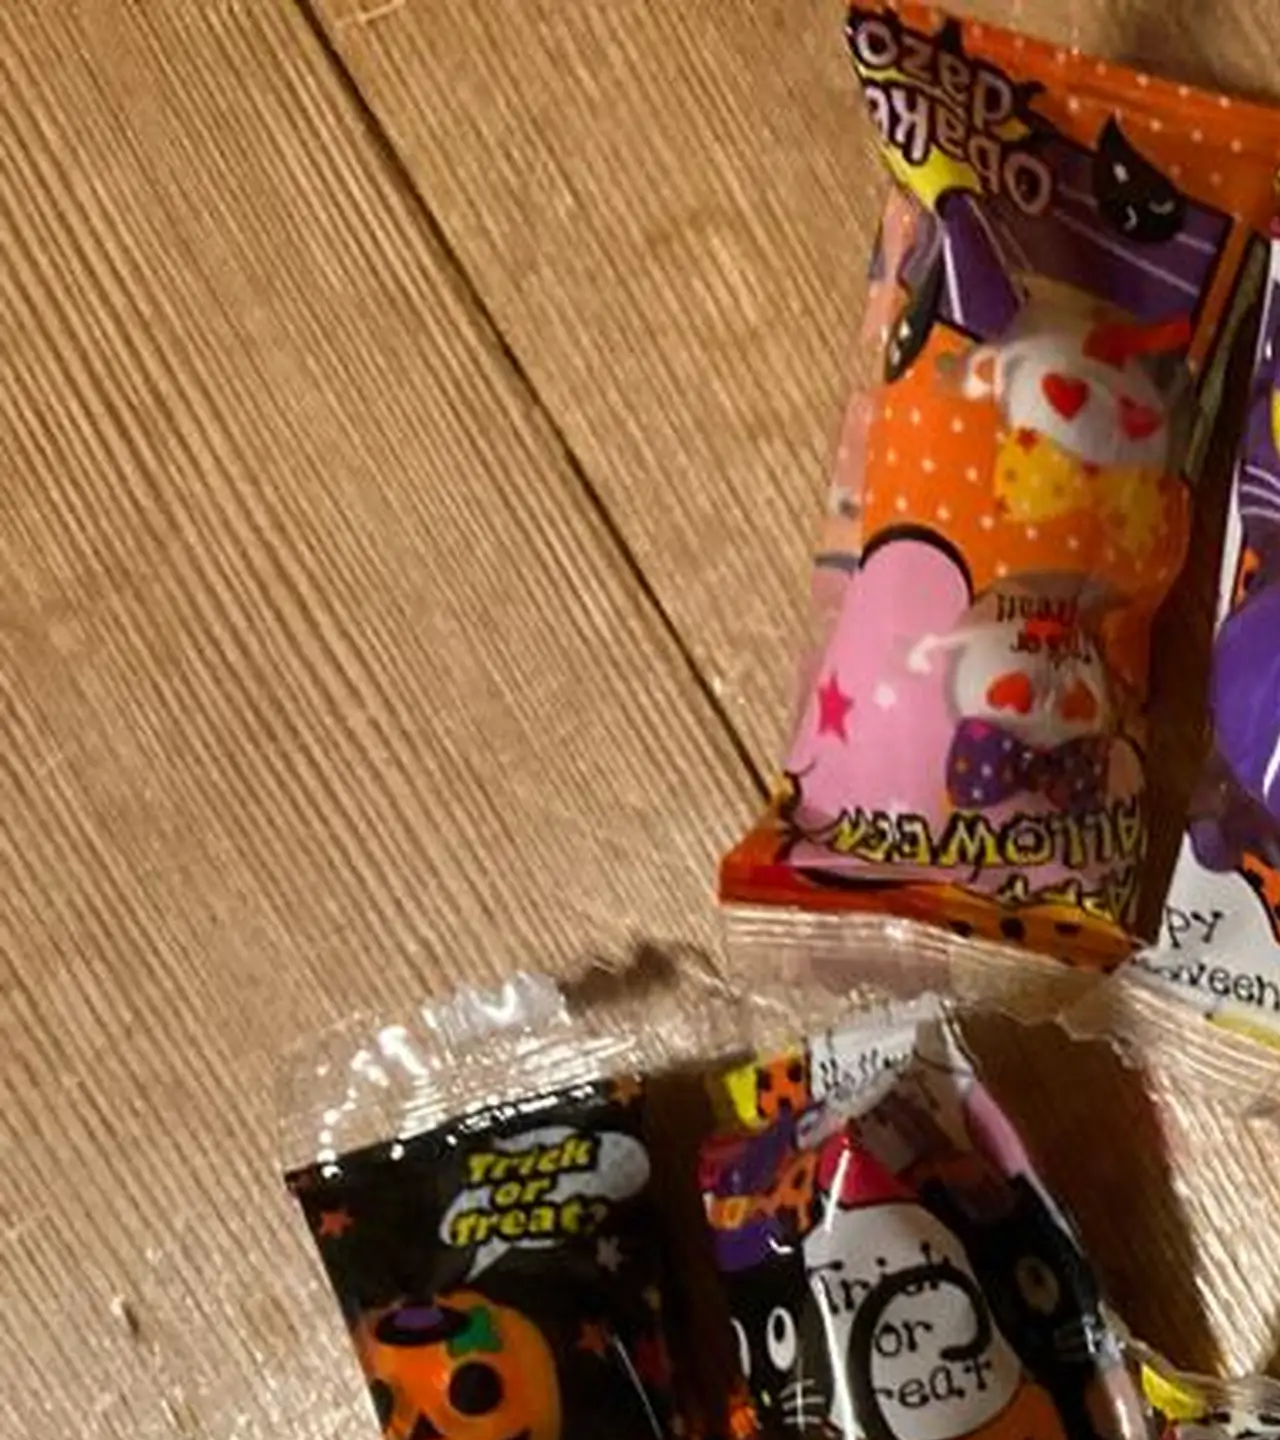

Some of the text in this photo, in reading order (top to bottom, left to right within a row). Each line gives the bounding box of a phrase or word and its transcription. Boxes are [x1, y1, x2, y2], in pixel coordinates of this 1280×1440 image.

[467, 1137, 595, 1183] Trick
[494, 1177, 553, 1208] or
[874, 1319, 934, 1357] or
